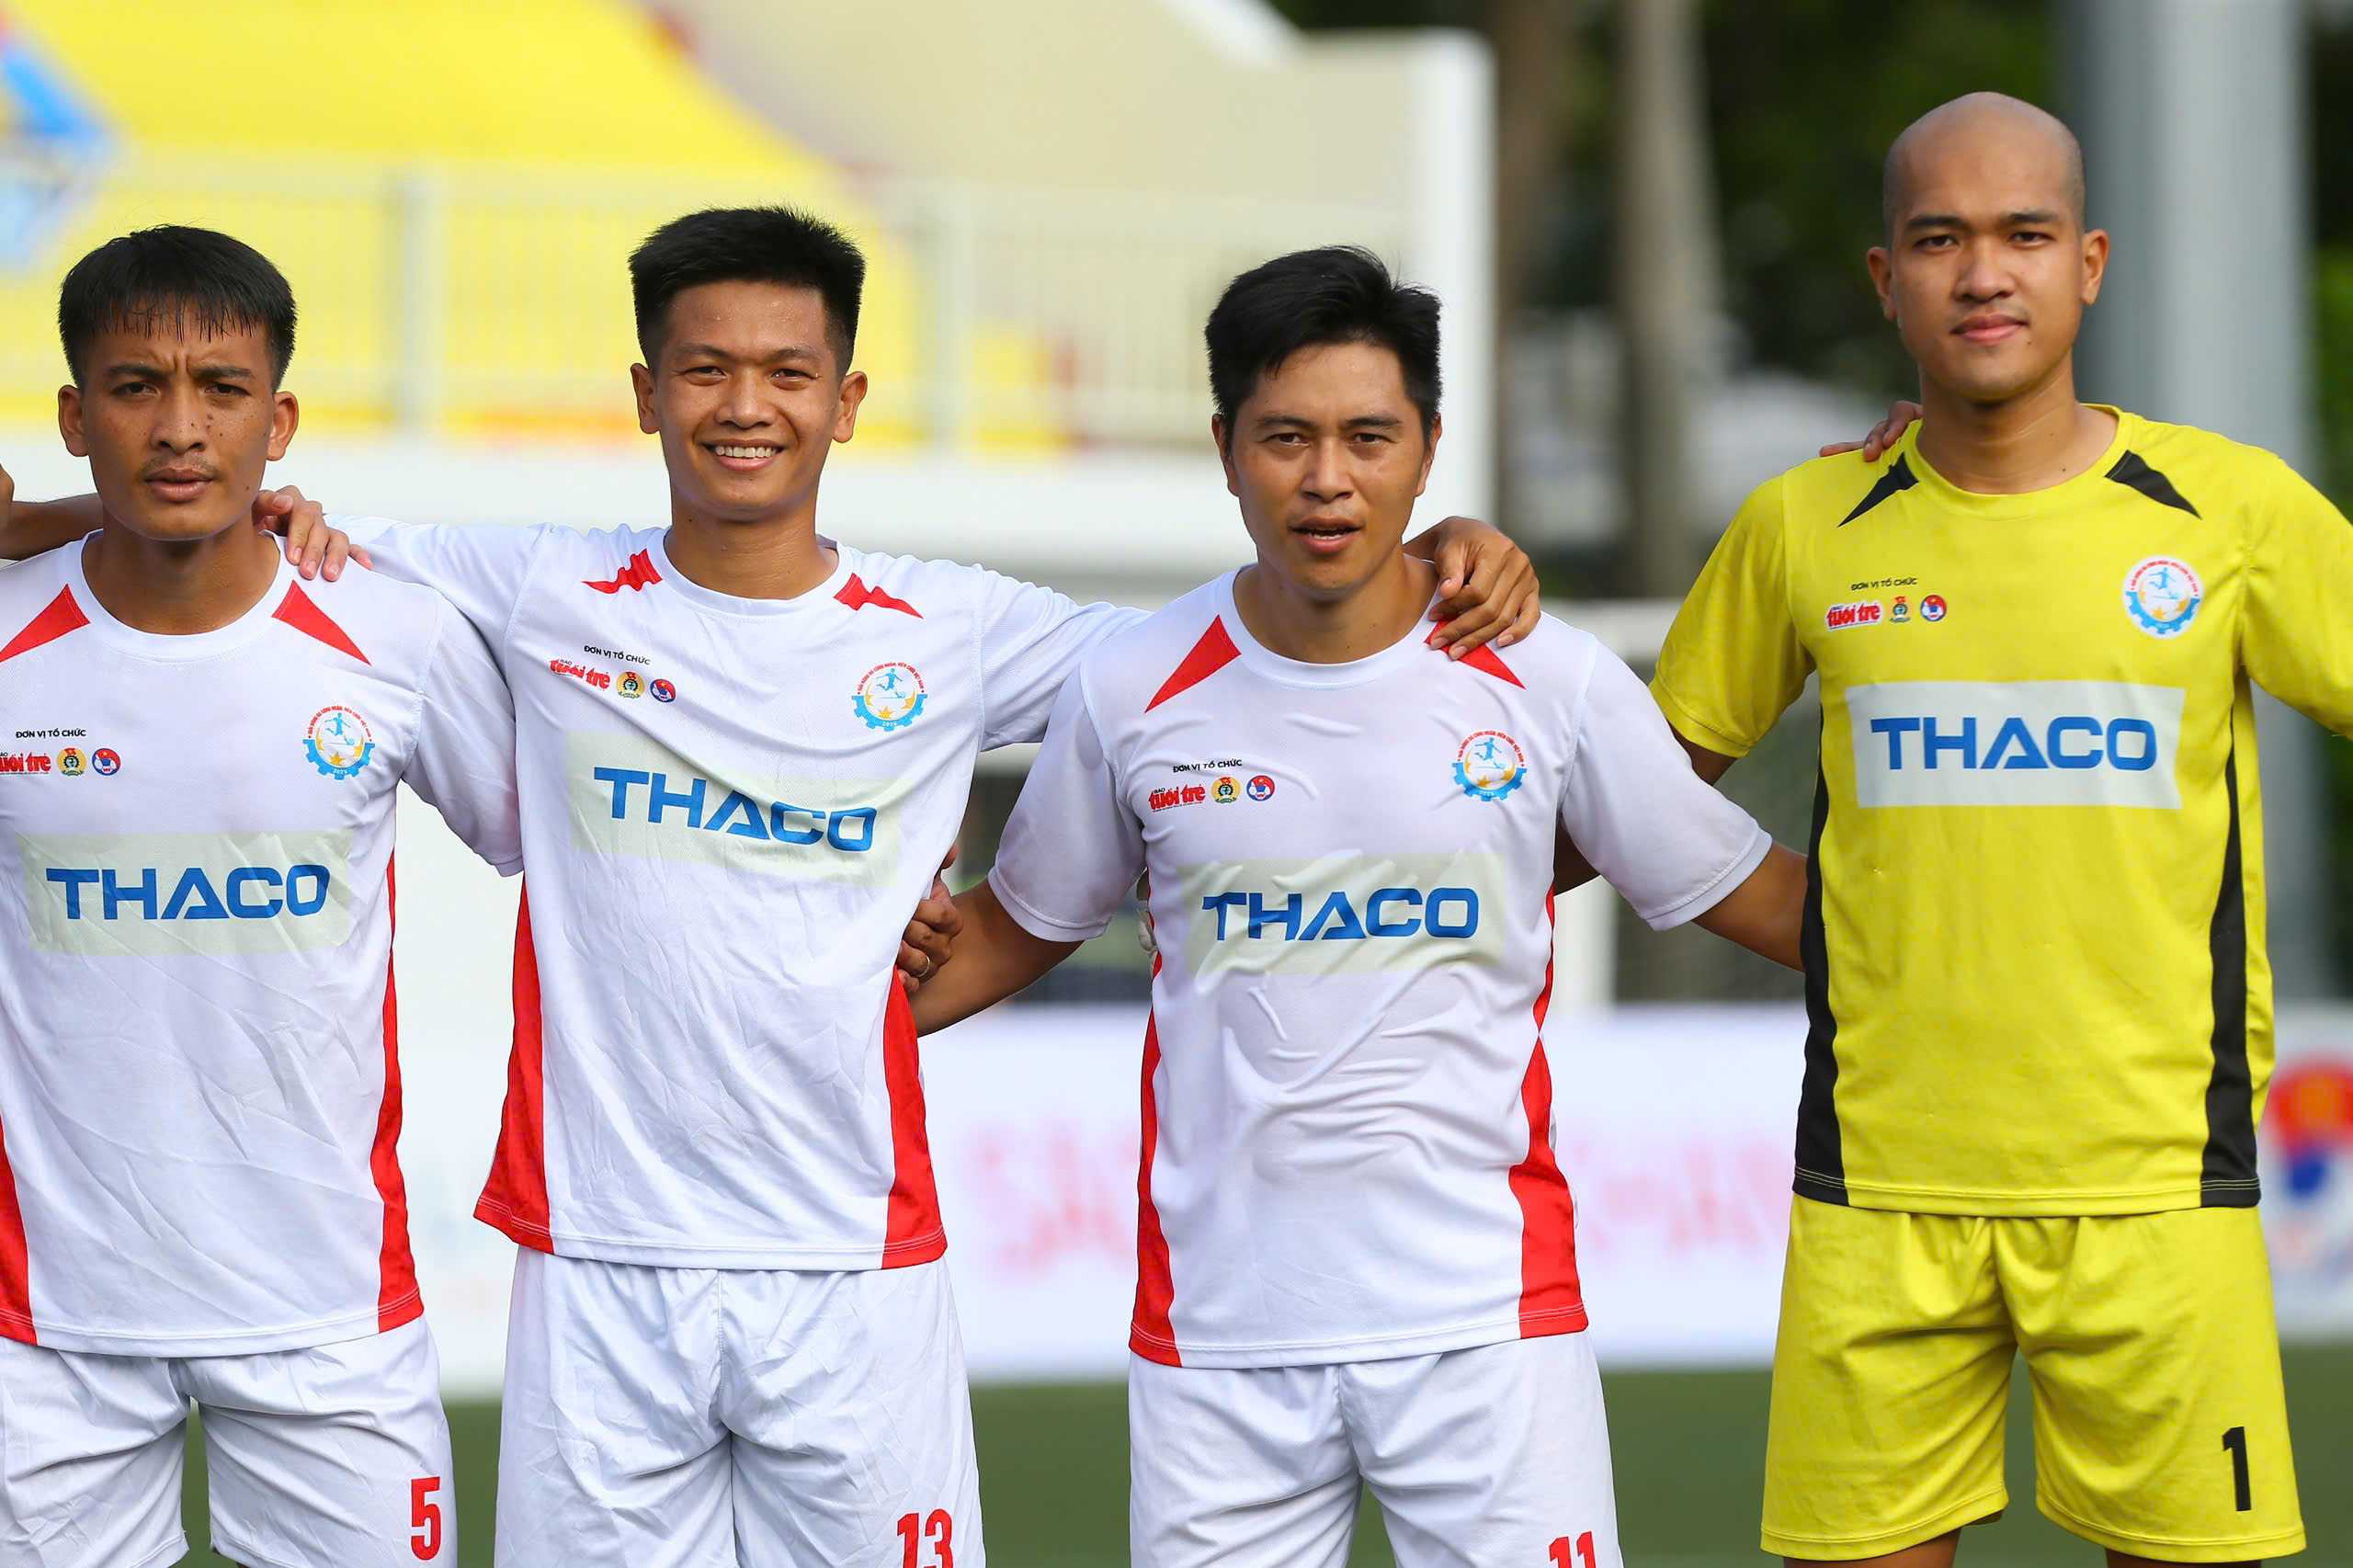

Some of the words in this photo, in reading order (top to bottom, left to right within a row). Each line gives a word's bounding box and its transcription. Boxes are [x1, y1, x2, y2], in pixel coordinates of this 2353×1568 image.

[584, 645, 601, 655] ĐƠN
[603, 649, 611, 659] VỊ
[15, 730, 35, 739] ĐƠN
[37, 730, 46, 739] VỊ
[62, 728, 86, 737] CHỨC
[1871, 717, 2156, 771] THACO
[1173, 764, 1190, 773] ĐƠN
[1191, 763, 1200, 771] VỊ
[1217, 758, 1243, 768] CHỨC
[596, 767, 878, 852] THACO
[46, 864, 330, 920] THACO
[1202, 887, 1479, 941] THACO
[2222, 1426, 2252, 1512] 1
[410, 1476, 441, 1561] 5
[897, 1508, 953, 1568] 13
